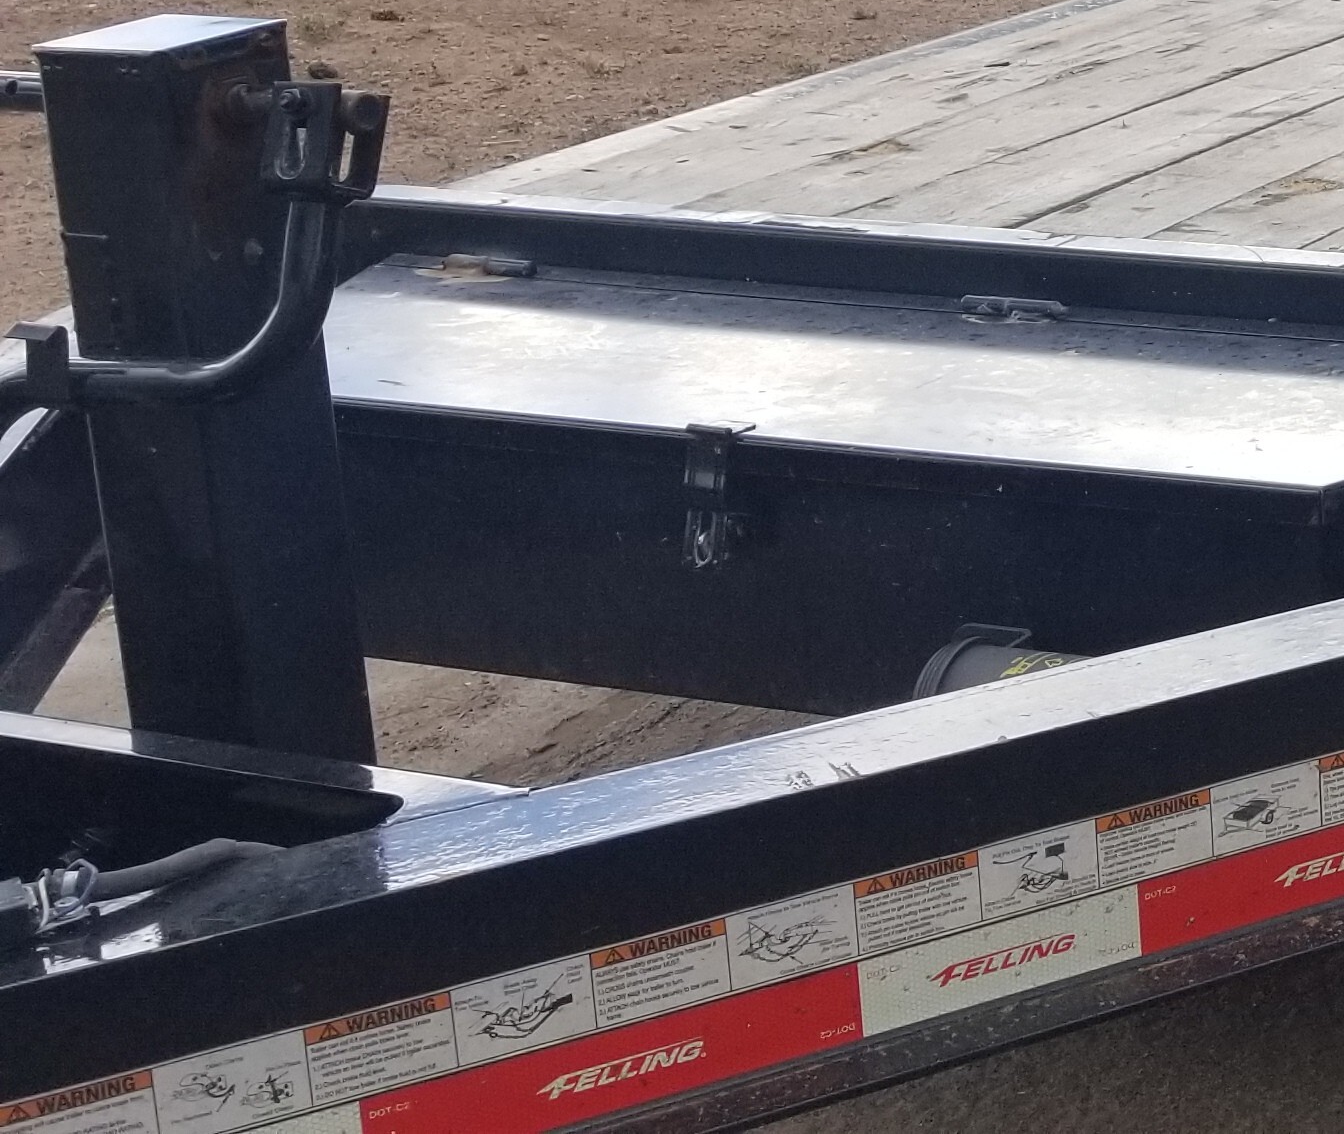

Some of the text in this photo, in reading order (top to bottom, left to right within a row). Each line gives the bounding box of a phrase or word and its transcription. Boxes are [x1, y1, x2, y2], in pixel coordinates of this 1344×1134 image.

[1129, 794, 1199, 823] WARNING
[889, 857, 966, 887] WARNING
[630, 924, 712, 957] WARNING
[929, 933, 1076, 987] FELLING
[346, 997, 437, 1033] WARNING
[536, 1036, 704, 1100] FELLING
[37, 1076, 136, 1116] WARNING
